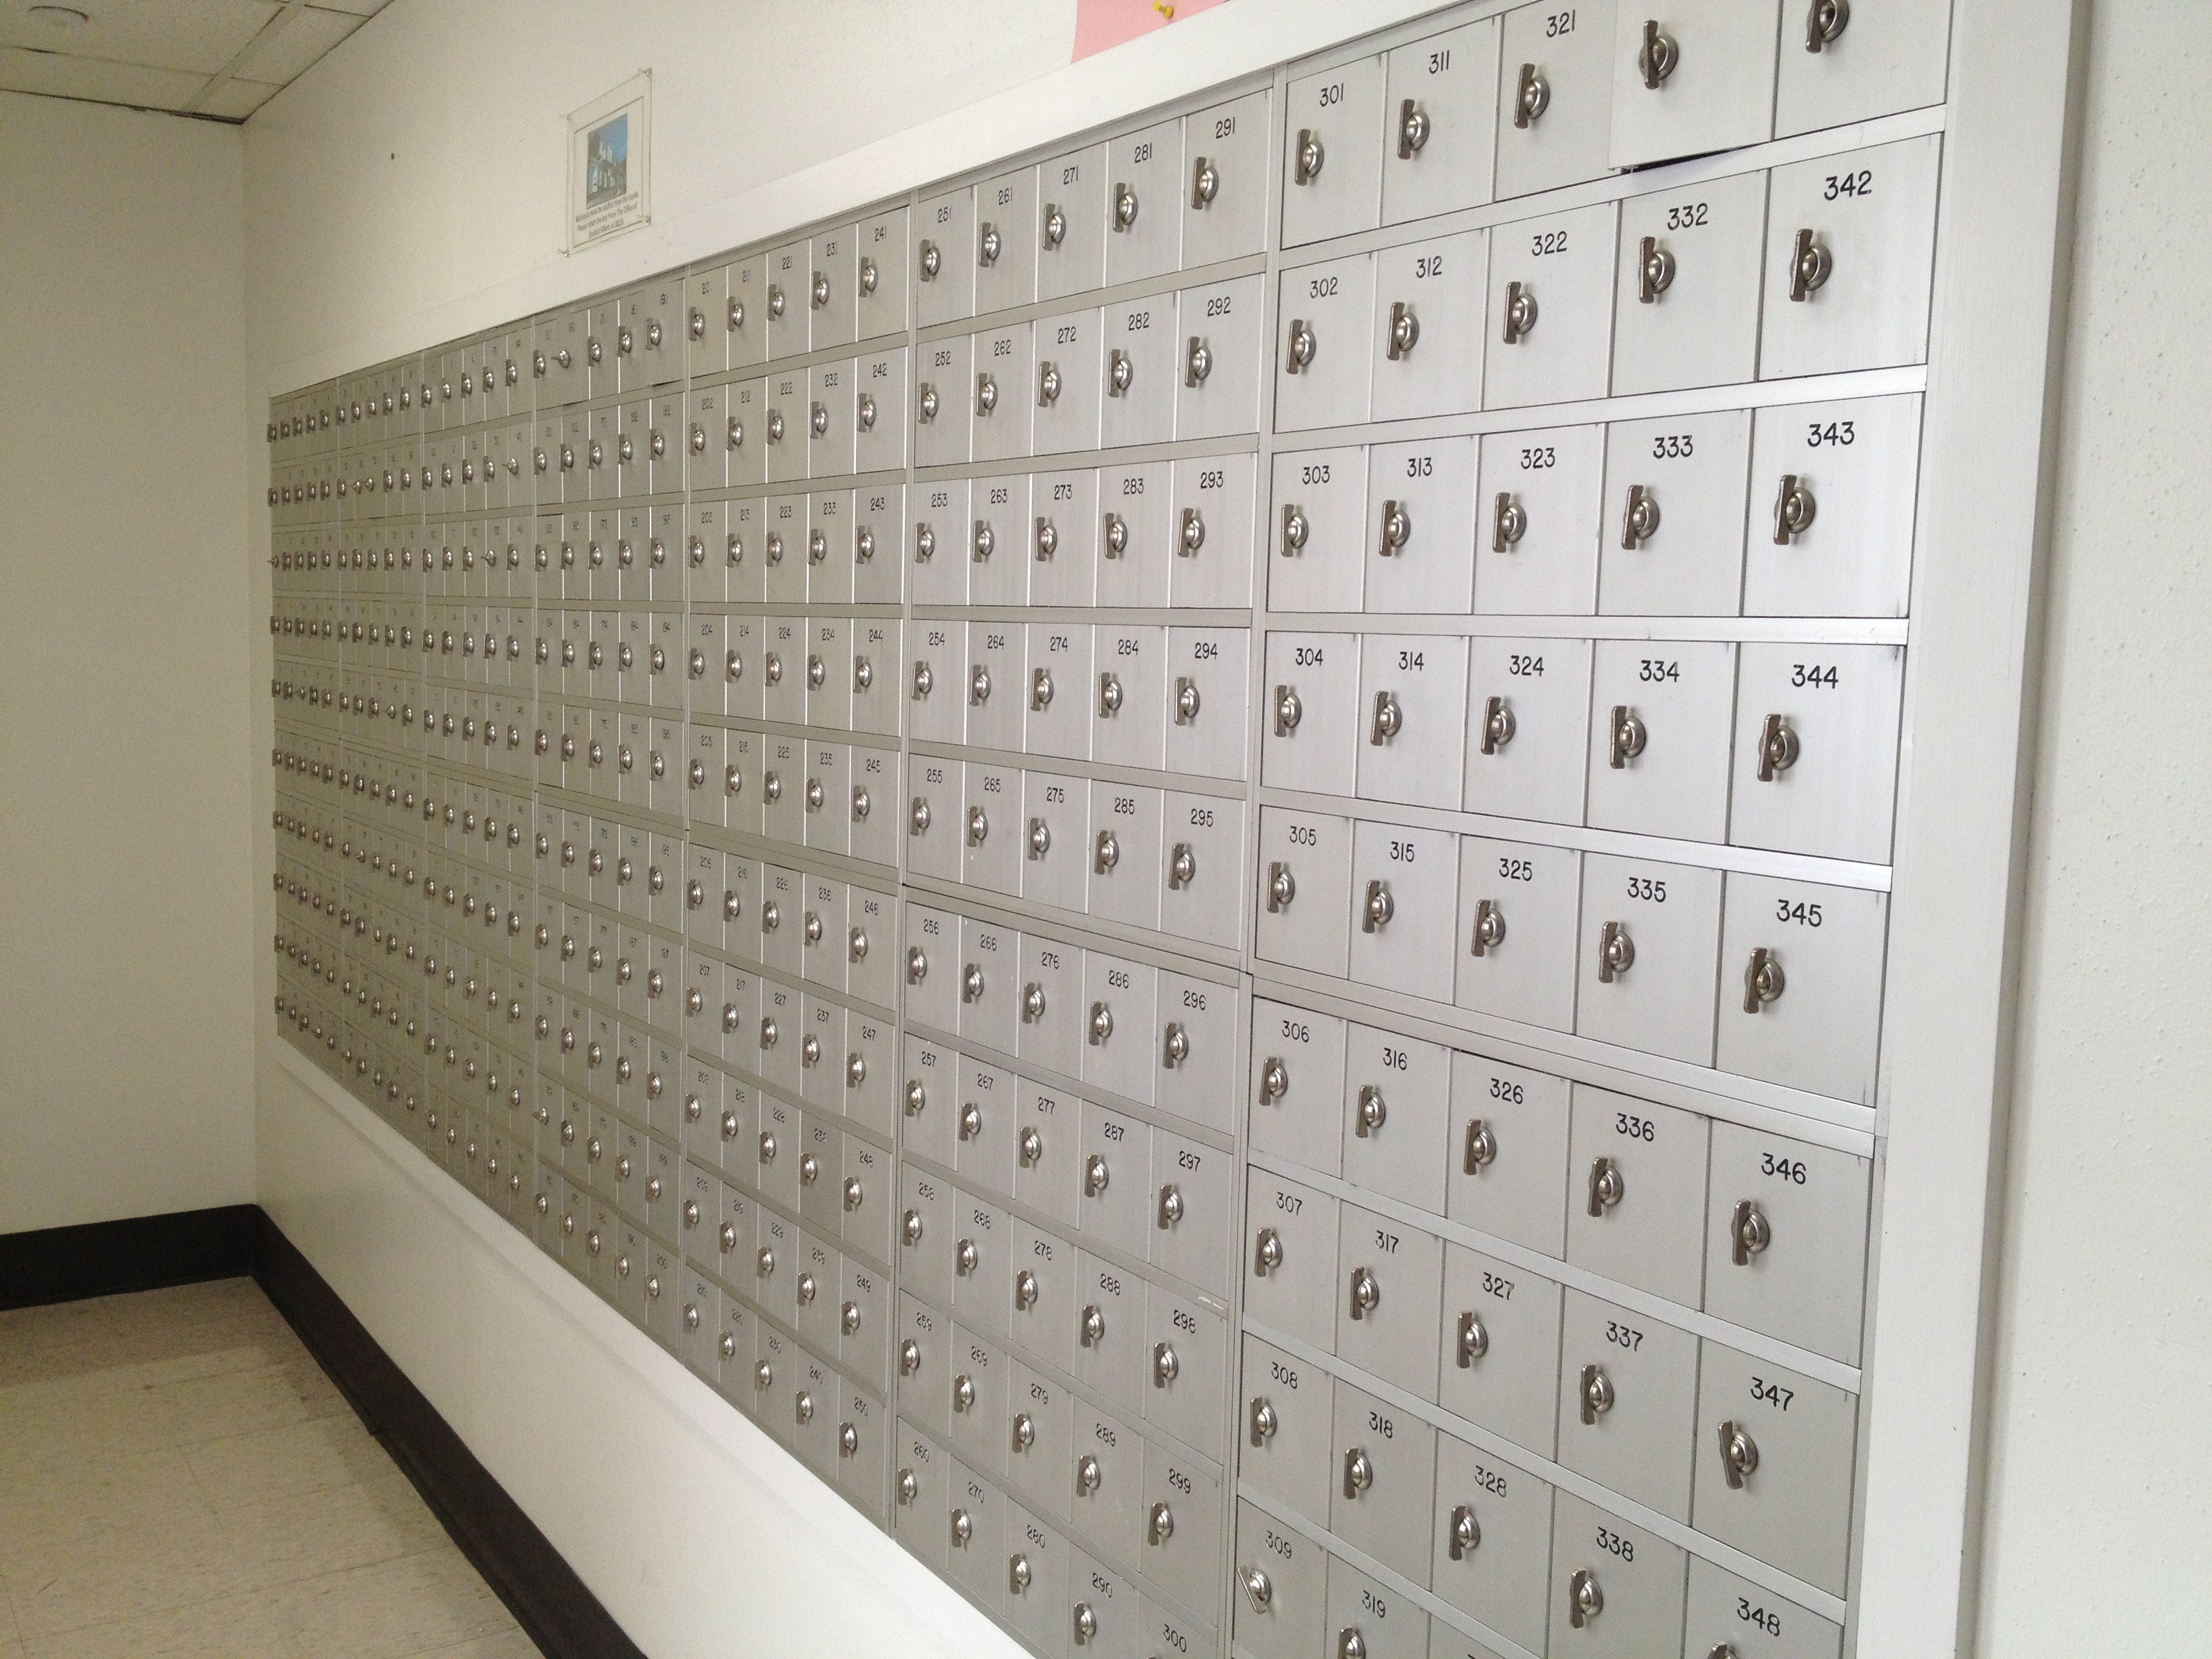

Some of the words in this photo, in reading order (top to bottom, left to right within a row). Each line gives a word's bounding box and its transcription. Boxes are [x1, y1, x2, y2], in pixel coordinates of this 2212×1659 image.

[1547, 9, 1575, 37] 321
[1429, 50, 1450, 74] 311
[1319, 83, 1344, 107] 301
[1216, 117, 1235, 139] 291
[1134, 142, 1152, 163] 281
[1063, 165, 1078, 185] 271
[1824, 170, 1872, 201] 342
[998, 187, 1012, 205] 261
[938, 207, 951, 223] 251
[1668, 203, 1708, 230] 332
[874, 226, 887, 243] 241
[1532, 231, 1567, 256] 322
[826, 242, 838, 258] 231
[781, 255, 793, 270] 221
[1416, 255, 1441, 279] 312
[1310, 276, 1338, 299] 302
[1208, 296, 1231, 316] 292
[1128, 312, 1149, 331] 282
[1058, 327, 1076, 344] 272
[995, 340, 1010, 356] 262
[935, 351, 951, 367] 252
[824, 372, 838, 388] 232
[872, 363, 887, 378] 242
[780, 381, 793, 396] 222
[1807, 422, 1854, 447] 343
[1653, 435, 1693, 459] 333
[1408, 457, 1432, 477] 313
[1521, 447, 1555, 469] 323
[1200, 471, 1223, 489] 293
[1303, 466, 1330, 485] 303
[991, 489, 1007, 504] 263
[1054, 485, 1071, 500] 273
[1124, 478, 1144, 495] 283
[823, 501, 836, 516] 233
[870, 497, 885, 512] 243
[932, 493, 947, 507] 253
[779, 505, 792, 519] 223
[778, 626, 791, 640] 224
[821, 628, 835, 641] 234
[869, 629, 883, 642] 244
[929, 632, 945, 646] 254
[987, 635, 1004, 649] 264
[1050, 636, 1067, 651] 274
[1118, 639, 1139, 655] 284
[1195, 642, 1218, 659] 294
[1296, 648, 1323, 666] 304
[1399, 651, 1424, 671] 314
[1510, 655, 1544, 676] 324
[1640, 660, 1679, 682] 334
[1792, 665, 1839, 689] 344
[777, 745, 790, 759] 225
[820, 752, 832, 766] 235
[866, 758, 880, 773] 245
[927, 769, 942, 783] 255
[985, 777, 1000, 793] 265
[1047, 787, 1064, 803] 275
[1115, 798, 1134, 815] 285
[1191, 808, 1213, 827] 295
[1290, 825, 1316, 846] 305
[1391, 841, 1414, 862] 315
[1499, 858, 1532, 881] 325
[818, 886, 832, 902] 236
[1628, 877, 1666, 903] 335
[864, 900, 878, 916] 246
[1776, 899, 1822, 927] 345
[924, 919, 939, 935] 256
[981, 935, 997, 951] 266
[1042, 951, 1059, 969] 276
[1109, 970, 1128, 989] 286
[774, 991, 787, 1006] 227
[1184, 990, 1206, 1010] 296
[817, 1008, 830, 1023] 237
[862, 1025, 876, 1041] 247
[1282, 1020, 1309, 1042] 306
[922, 1051, 936, 1067] 257
[1383, 1048, 1407, 1071] 316
[978, 1073, 994, 1090] 267
[1490, 1078, 1523, 1104] 326
[1038, 1097, 1054, 1114] 277
[1105, 1122, 1124, 1141] 287
[1616, 1113, 1654, 1142] 336
[860, 1151, 874, 1168] 248
[1179, 1151, 1200, 1171] 297
[1761, 1153, 1806, 1185] 346
[919, 1183, 933, 1200] 258
[1277, 1191, 1303, 1216] 307
[975, 1210, 990, 1229] 268
[1035, 1240, 1052, 1261] 278
[1376, 1230, 1399, 1254] 317
[857, 1274, 871, 1292] 249
[1101, 1273, 1120, 1296] 288
[1483, 1272, 1514, 1300] 327
[917, 1312, 931, 1331] 259
[1174, 1310, 1195, 1334] 298
[1606, 1321, 1643, 1351] 337
[971, 1346, 987, 1366] 269
[1271, 1361, 1297, 1389] 308
[1031, 1383, 1048, 1404] 279
[1750, 1377, 1794, 1411] 347
[855, 1397, 867, 1417] 250
[1097, 1423, 1115, 1447] 289
[1369, 1412, 1393, 1439] 318
[914, 1441, 929, 1462] 260
[1169, 1469, 1191, 1494] 299
[1475, 1465, 1506, 1498] 328
[968, 1481, 984, 1503] 270
[1027, 1525, 1045, 1549] 280
[1266, 1530, 1292, 1559] 309
[1597, 1527, 1633, 1562] 338
[1092, 1572, 1112, 1598] 290
[1362, 1590, 1385, 1618] 319
[1737, 1597, 1780, 1637] 348
[1164, 1624, 1187, 1653] 300
